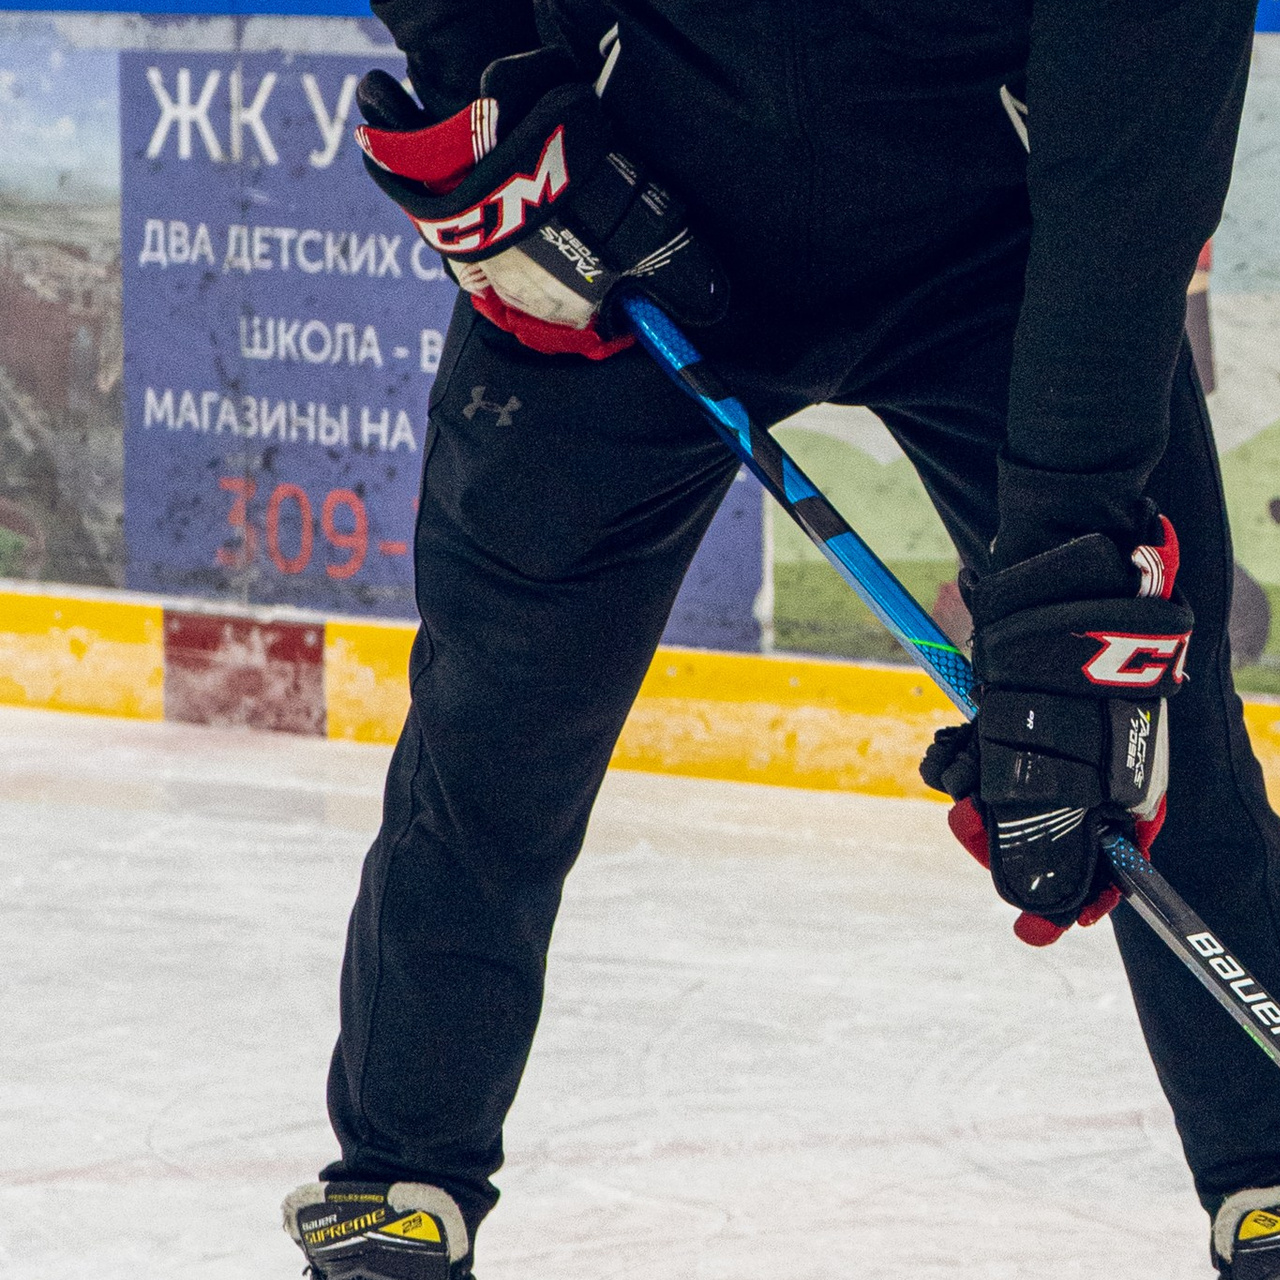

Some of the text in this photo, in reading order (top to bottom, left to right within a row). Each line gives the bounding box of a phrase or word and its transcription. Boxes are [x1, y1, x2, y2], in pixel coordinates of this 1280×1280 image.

[147, 66, 358, 168] ЖК У
[139, 218, 450, 281] ДВА ДЕТСКИХ С
[539, 224, 603, 284] TACKS
[239, 316, 384, 368] ШКОЛА
[144, 386, 418, 452] МАГАЗИНЫ НА
[214, 476, 418, 579] 309-
[1133, 707, 1151, 788] TACKS
